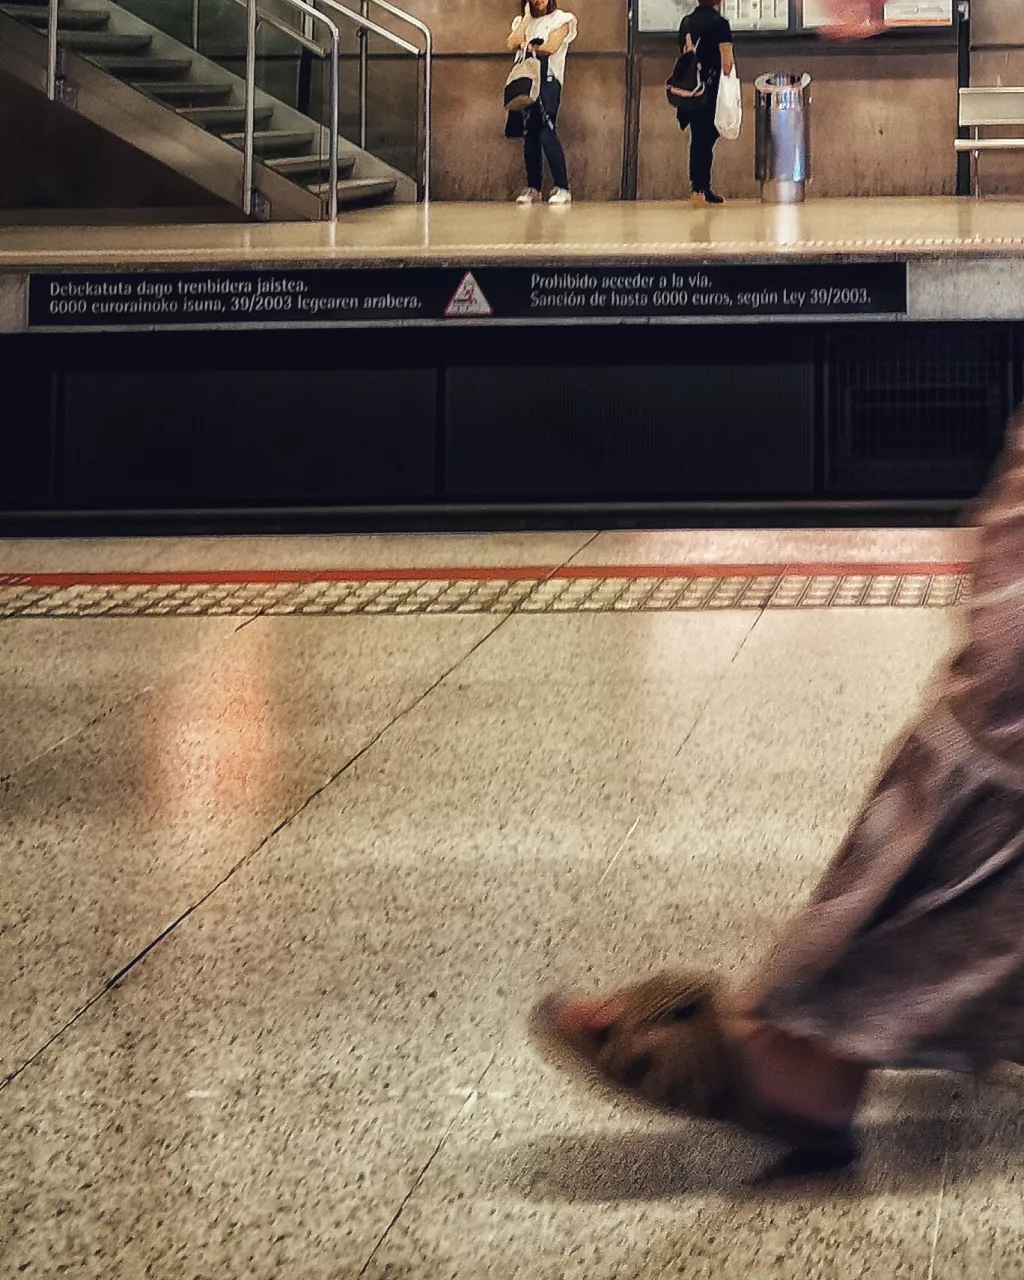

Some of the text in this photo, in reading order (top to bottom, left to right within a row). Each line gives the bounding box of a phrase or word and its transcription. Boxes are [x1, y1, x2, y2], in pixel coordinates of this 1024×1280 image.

[50, 281, 132, 297] Debekatuta
[137, 280, 173, 298] dago
[178, 278, 252, 295] trenbidera
[530, 272, 597, 289] Prohibido
[602, 272, 655, 288] acceder
[659, 275, 667, 288] a
[672, 271, 684, 288] la
[50, 293, 422, 315] 6000 eurorainoko isuna, 39/2003 legearen arabera.
[530, 287, 872, 308] Sanción de hasta 6000 euros, según Ley 39/2003.
